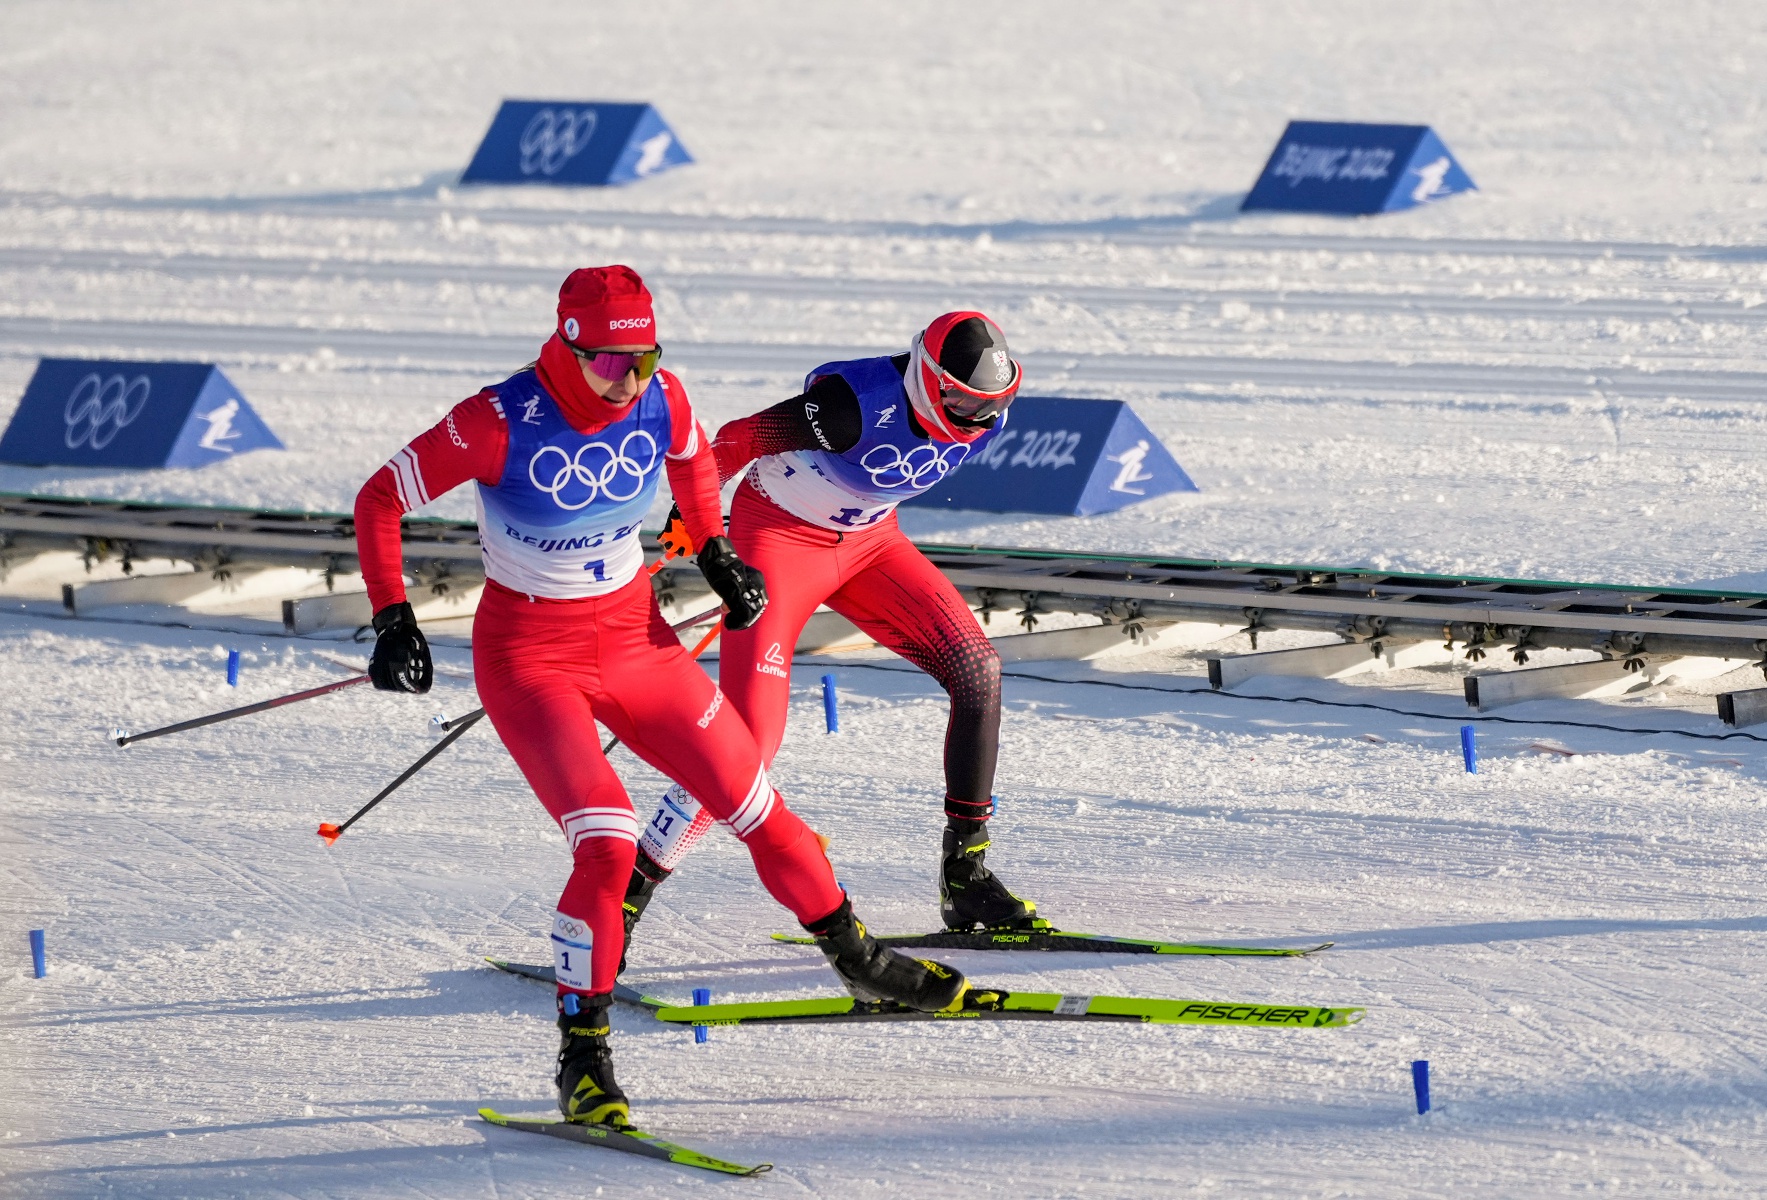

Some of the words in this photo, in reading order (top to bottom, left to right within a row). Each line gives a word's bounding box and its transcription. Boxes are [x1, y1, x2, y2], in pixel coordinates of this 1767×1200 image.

[609, 317, 648, 331] BOSCO
[1010, 429, 1082, 471] 2022
[504, 523, 604, 552] BEIJING
[756, 662, 787, 679] Löffler
[651, 808, 675, 838] 11
[992, 935, 1030, 943] FISCHER
[561, 951, 573, 972] 1
[1177, 1003, 1310, 1024] FISCHER
